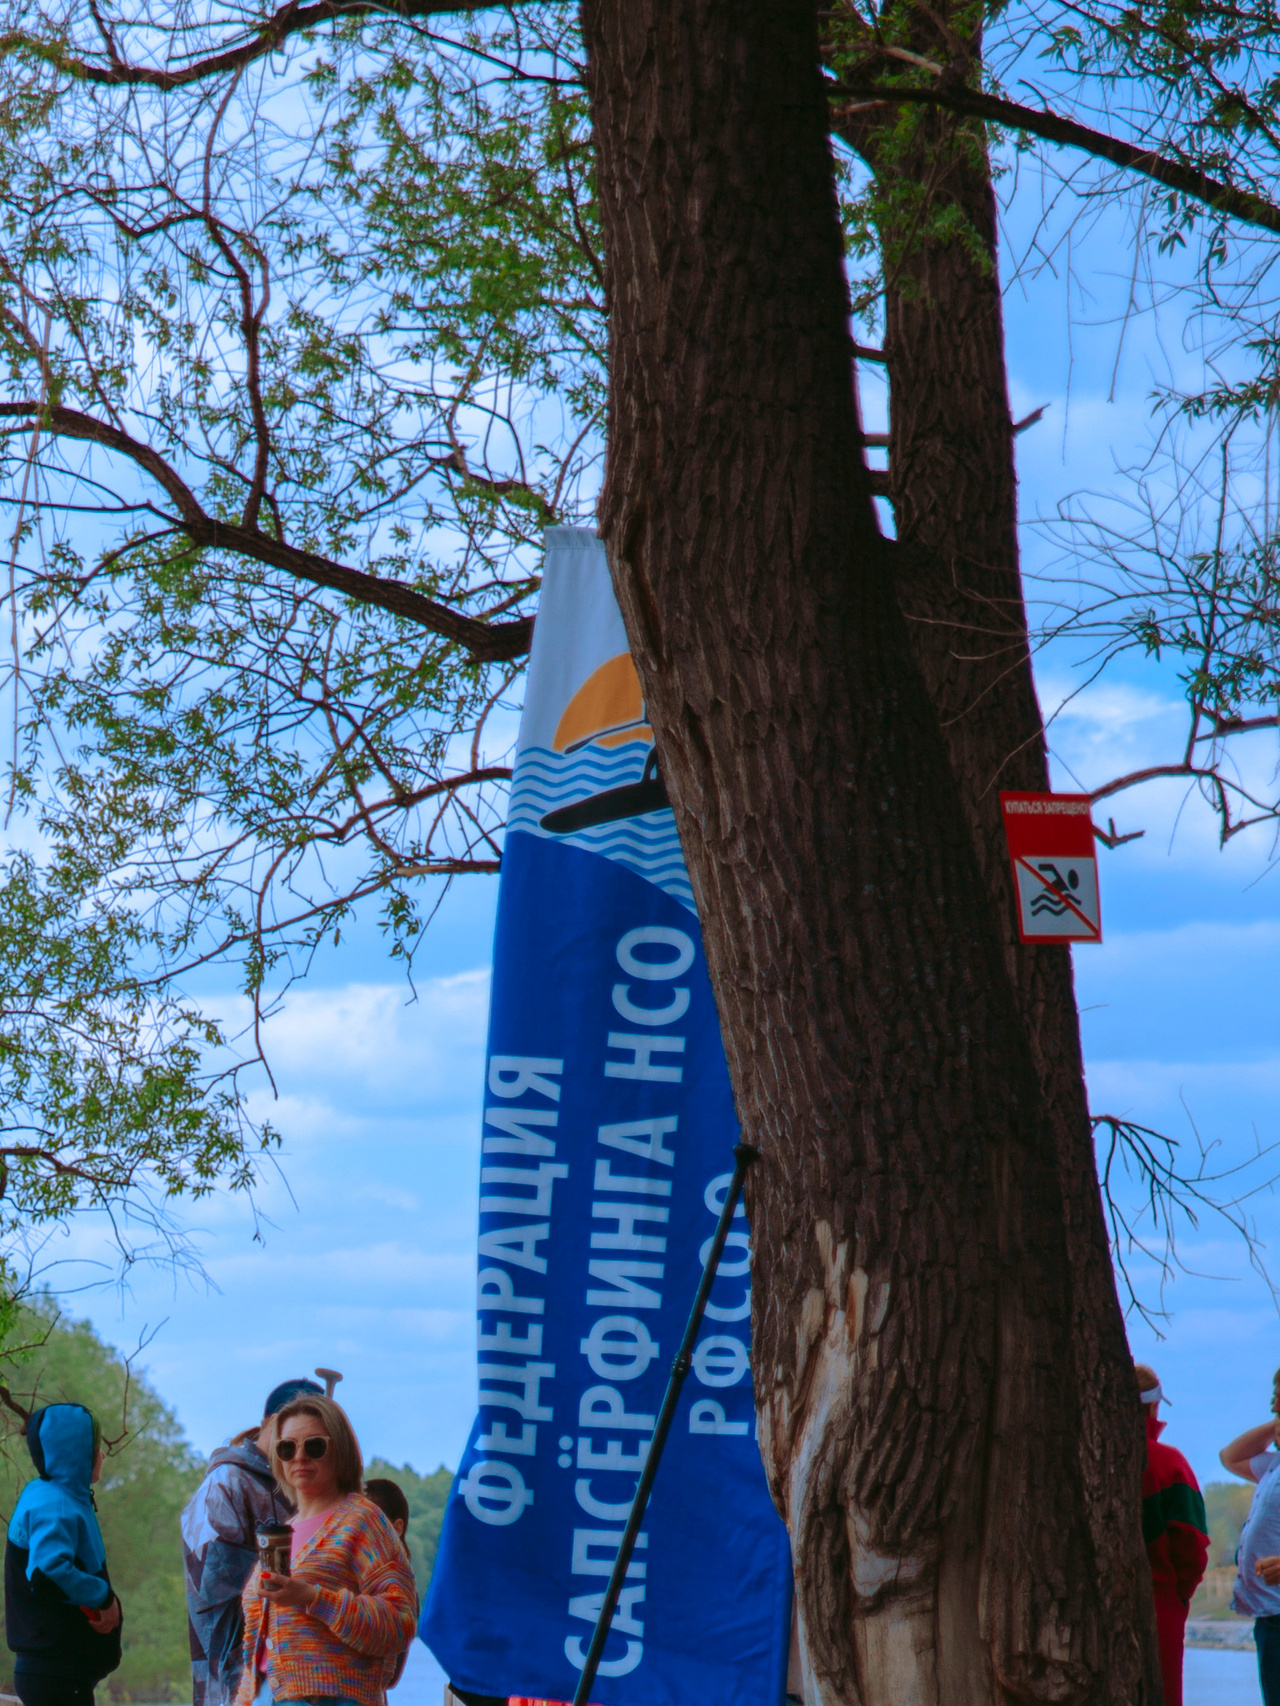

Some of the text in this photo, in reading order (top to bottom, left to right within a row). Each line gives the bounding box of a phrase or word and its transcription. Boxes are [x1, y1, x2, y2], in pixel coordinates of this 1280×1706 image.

[1004, 801, 1042, 815] КУПАТЬСЯ
[458, 1054, 568, 1527] ФЕДЕРАЦИЯ
[558, 925, 696, 1678] САПСЁРФИНГА НСО
